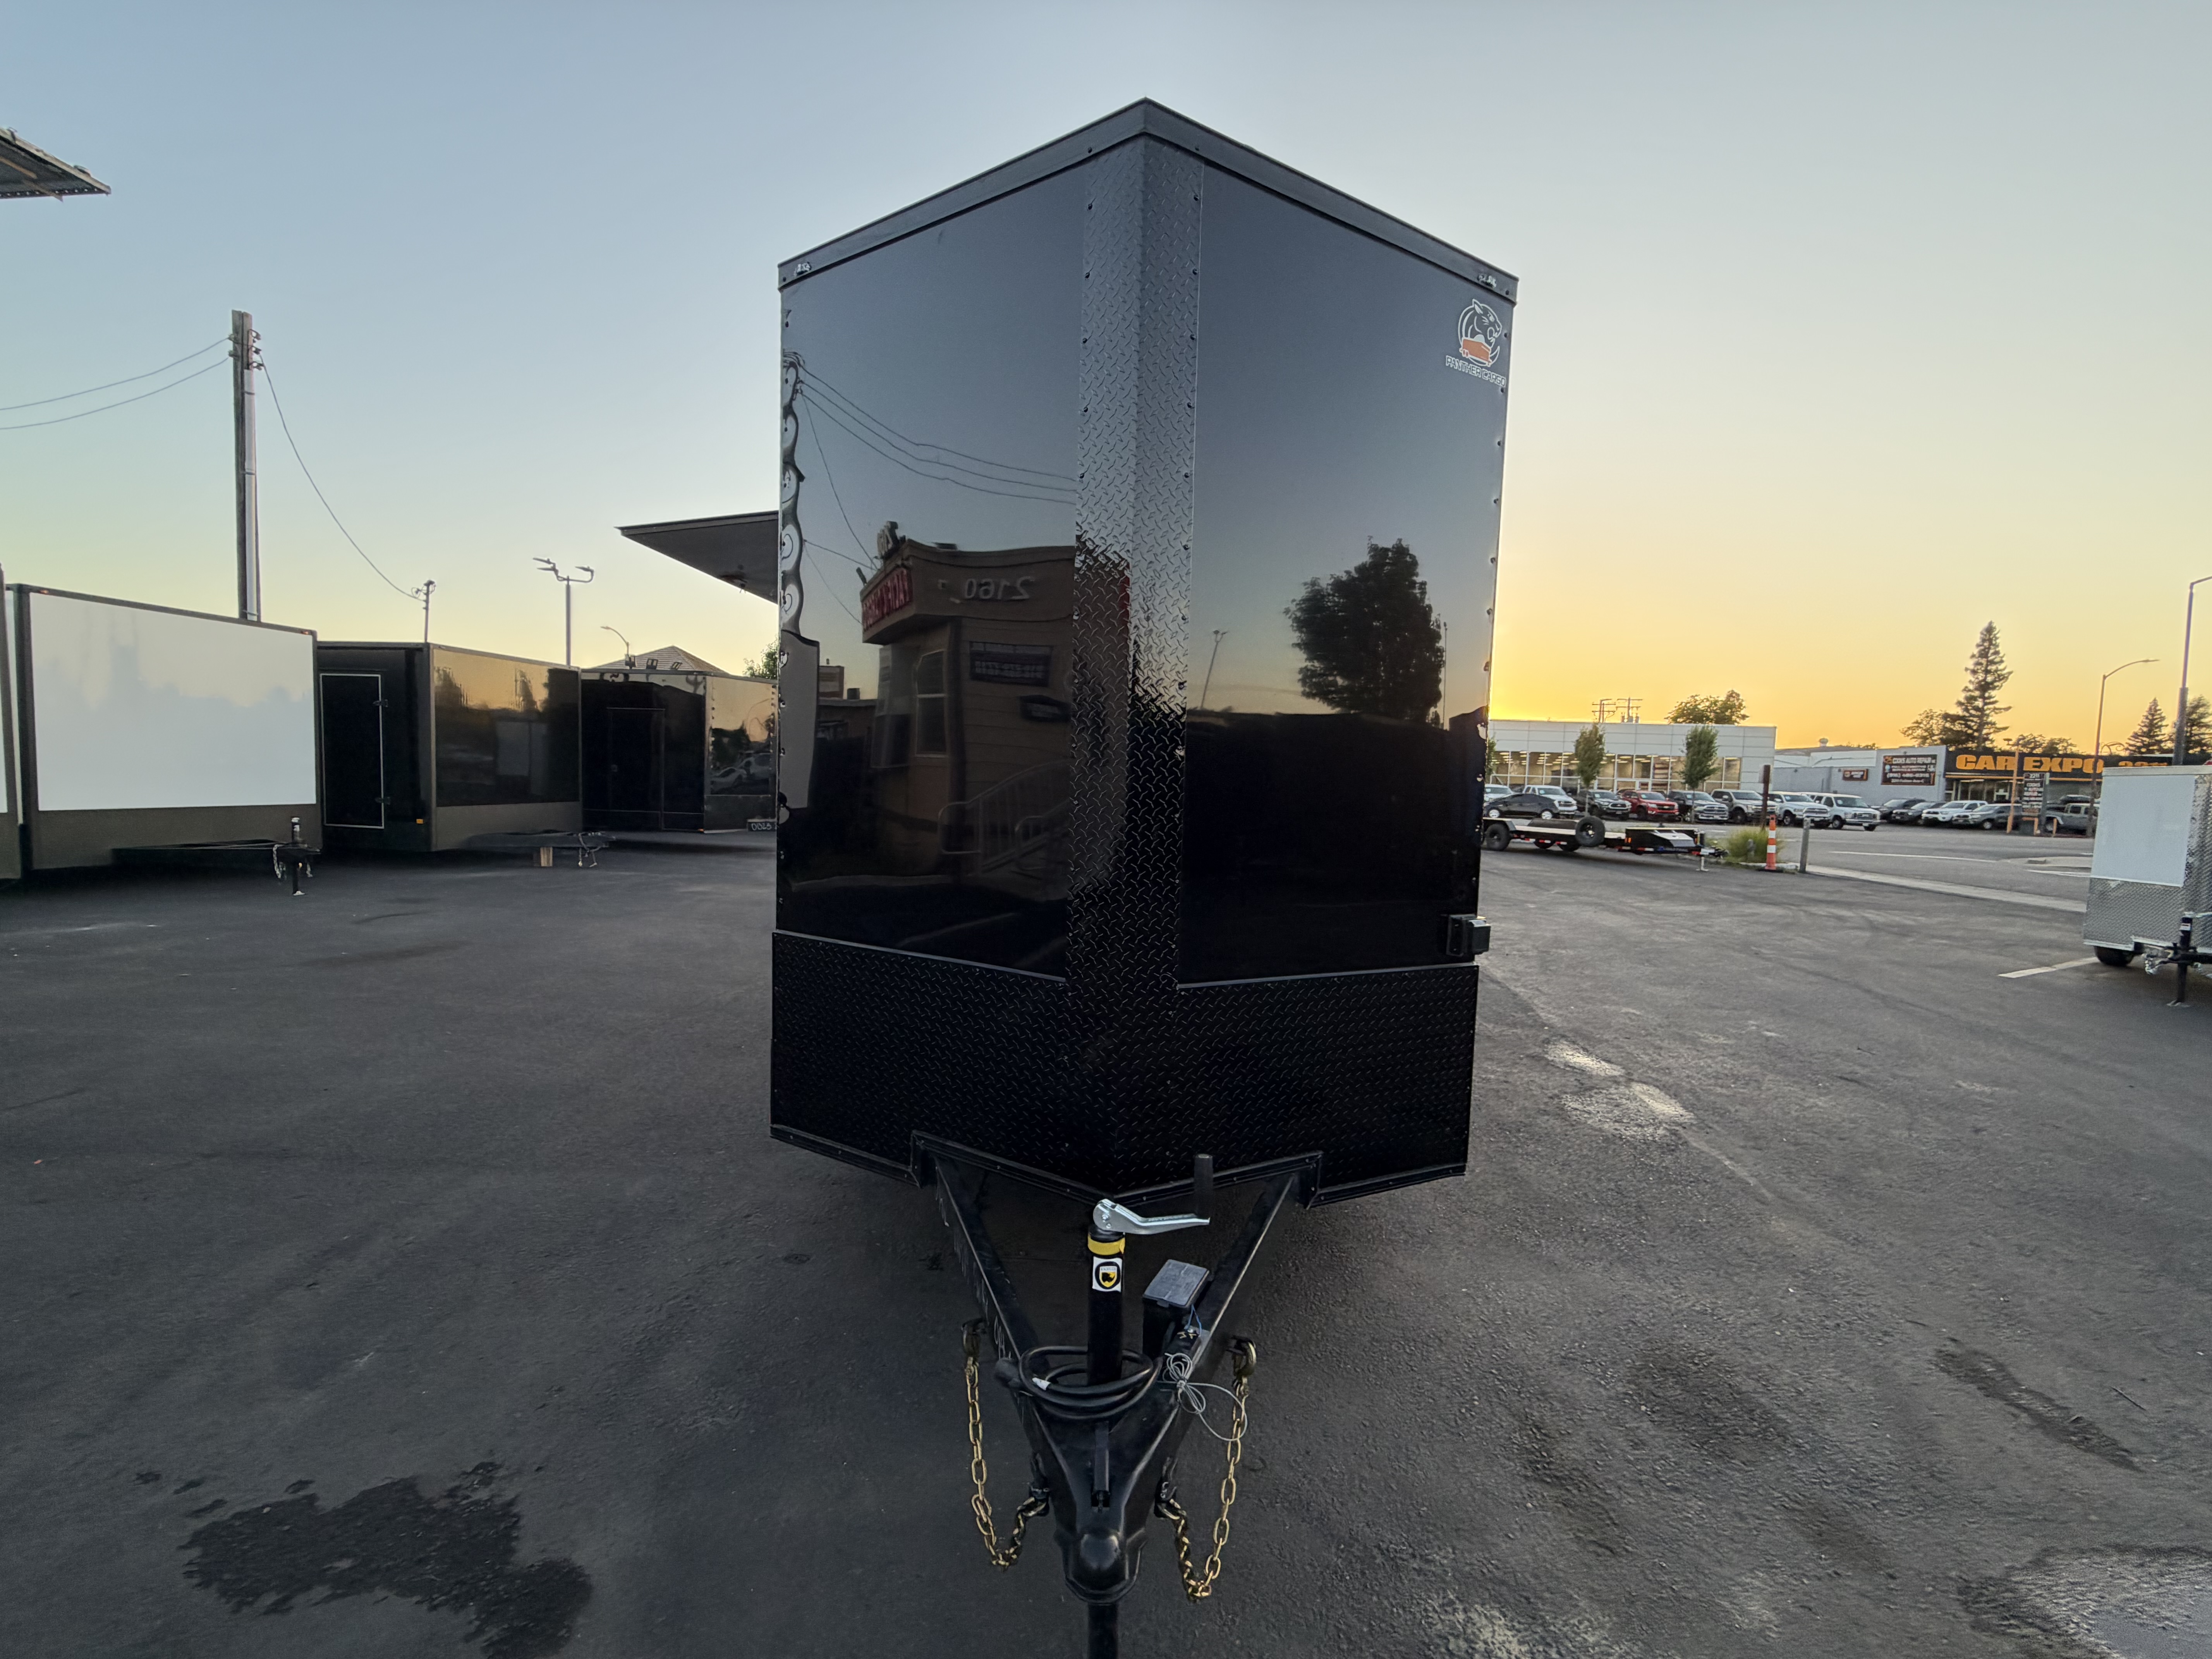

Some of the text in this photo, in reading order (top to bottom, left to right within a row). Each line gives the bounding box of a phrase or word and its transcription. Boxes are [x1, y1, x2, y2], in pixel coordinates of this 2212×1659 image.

[1446, 355, 1506, 387] PANTHER CARGO
[1956, 754, 2104, 773] CAR EXPO
